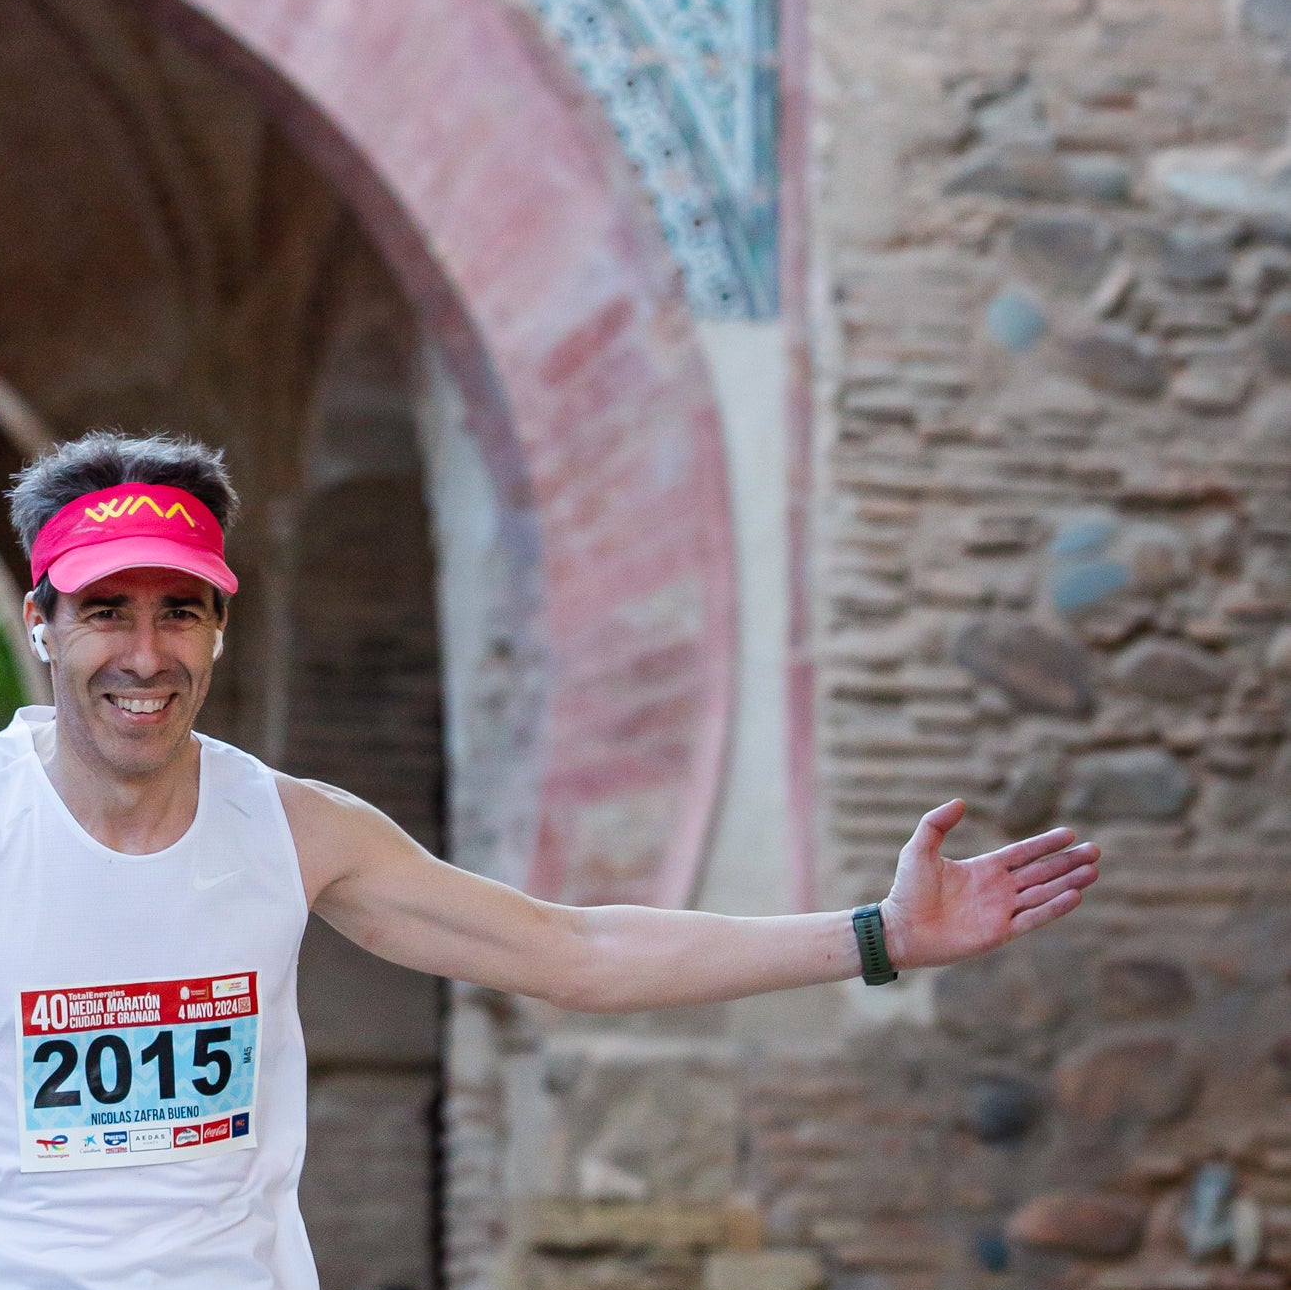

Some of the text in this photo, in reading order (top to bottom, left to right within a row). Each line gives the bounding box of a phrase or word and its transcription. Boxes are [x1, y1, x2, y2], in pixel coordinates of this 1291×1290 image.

[68, 989, 125, 1001] TotalEnergies
[69, 992, 161, 1016] MEDIA MARATÓN
[31, 994, 68, 1031] 40
[69, 1010, 161, 1029] CIUDAD DE GRANADA
[178, 998, 238, 1020] 4 MAYO 2024
[243, 1046, 252, 1064] M45
[33, 1026, 232, 1110] 2015
[91, 1105, 200, 1126] NICOLAS ZAFRA BUENO
